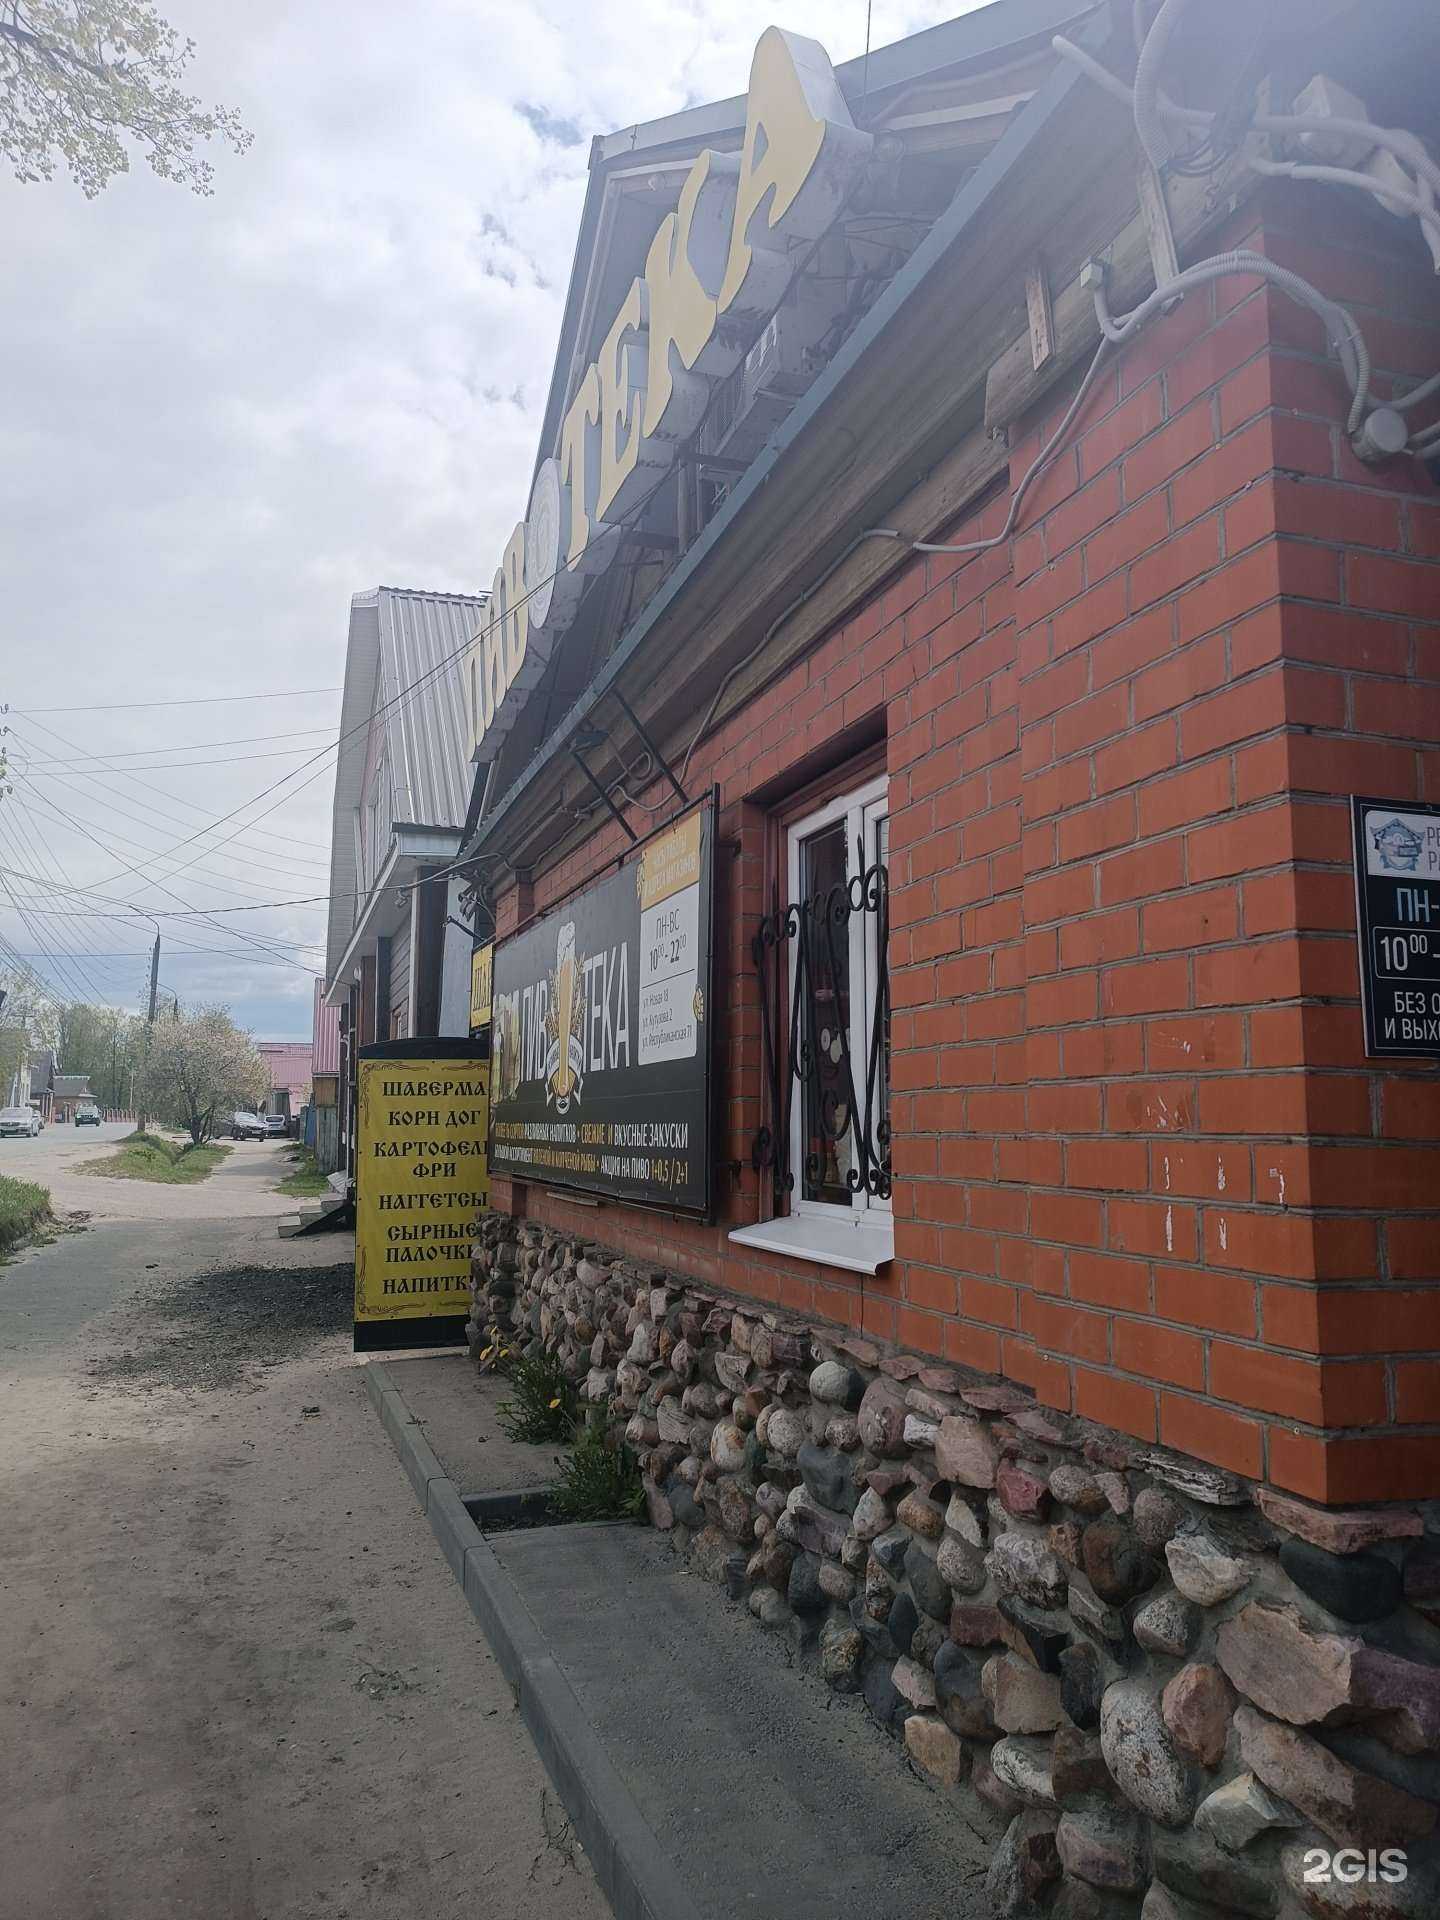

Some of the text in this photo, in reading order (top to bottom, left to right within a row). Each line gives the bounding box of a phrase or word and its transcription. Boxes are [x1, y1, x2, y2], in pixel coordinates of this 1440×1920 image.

[656, 908, 680, 940] ПН-ВС
[1394, 991, 1426, 1014] БЕЗ
[1384, 1017, 1440, 1041] И ВЫХ
[382, 1081, 488, 1097] ШАВЕРМА
[388, 1110, 481, 1128] КОРН ДОГ
[581, 1123, 605, 1144] СВЕЖИЕ
[614, 1123, 648, 1147] ВКУСНЫЕ
[649, 1123, 689, 1149] ЗАКУСКИ
[412, 1162, 457, 1178] ФРИ
[601, 1155, 620, 1181] АКЦИЯ
[621, 1156, 630, 1177] НА
[631, 1158, 650, 1180] ПИВО
[676, 1161, 689, 1184] 2+1
[378, 1191, 488, 1210] НАГГЕТСЫ
[387, 1222, 477, 1241] СЫРНЫЕ
[383, 1275, 472, 1295] НАПИТК
